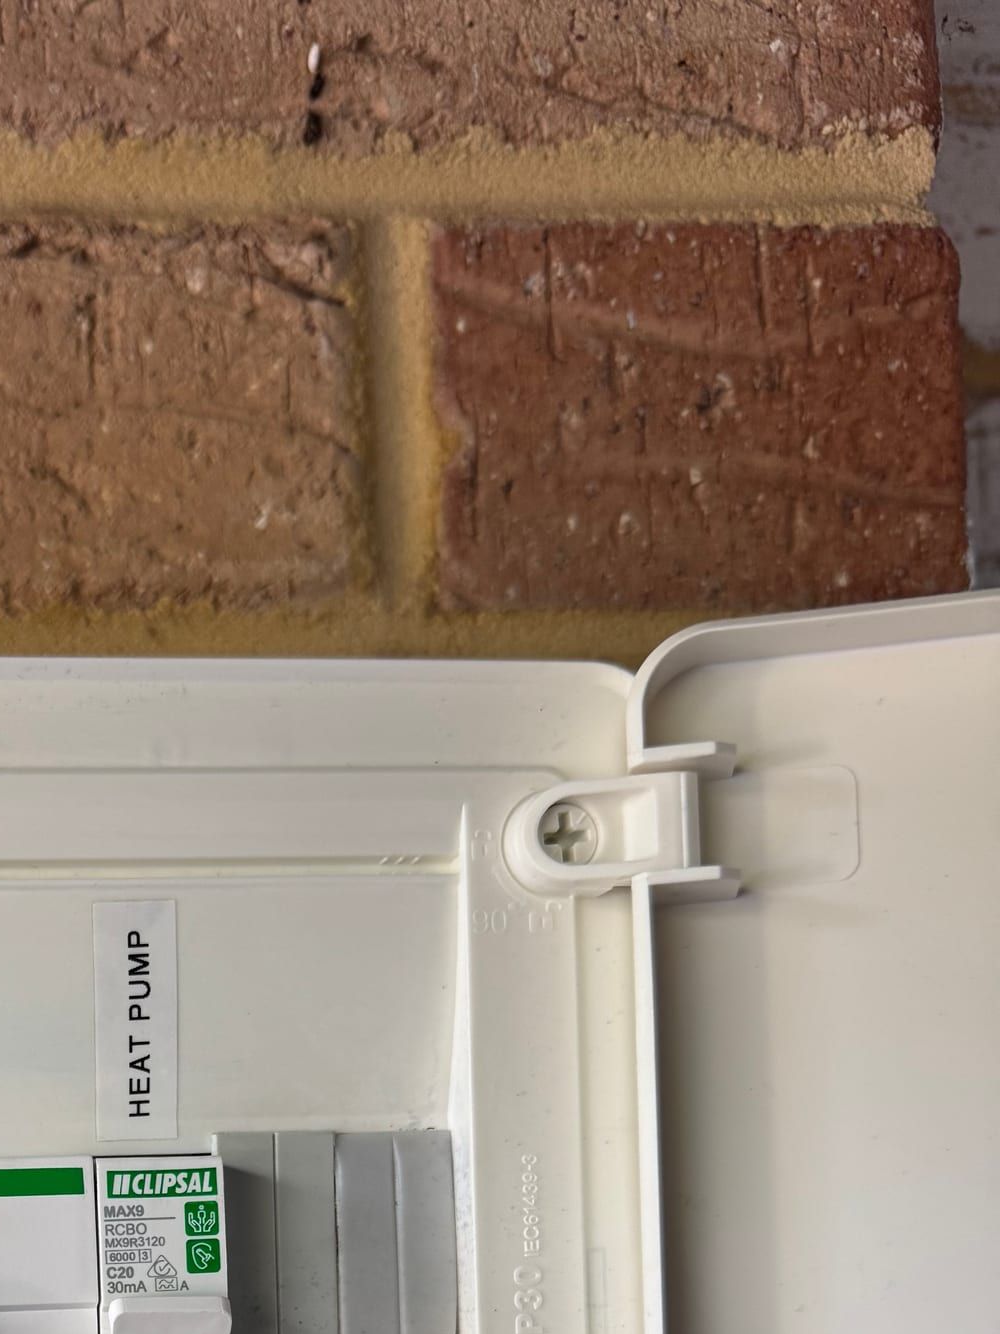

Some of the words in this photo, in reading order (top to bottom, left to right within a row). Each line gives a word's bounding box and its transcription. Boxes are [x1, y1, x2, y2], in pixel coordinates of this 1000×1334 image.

[127, 930, 151, 1021] PUMP
[128, 1035, 151, 1118] HEAT
[131, 1171, 213, 1195] CLIPSAL
[103, 1205, 145, 1218] MAX9
[521, 1153, 540, 1258] IEC61439-3
[104, 1223, 148, 1236] RCBO
[104, 1236, 166, 1249] MX9R3120
[109, 1251, 136, 1263] 6000
[141, 1251, 149, 1261] 3
[106, 1266, 135, 1279] C20
[107, 1281, 148, 1294] 30mA
[180, 1280, 190, 1291] A
